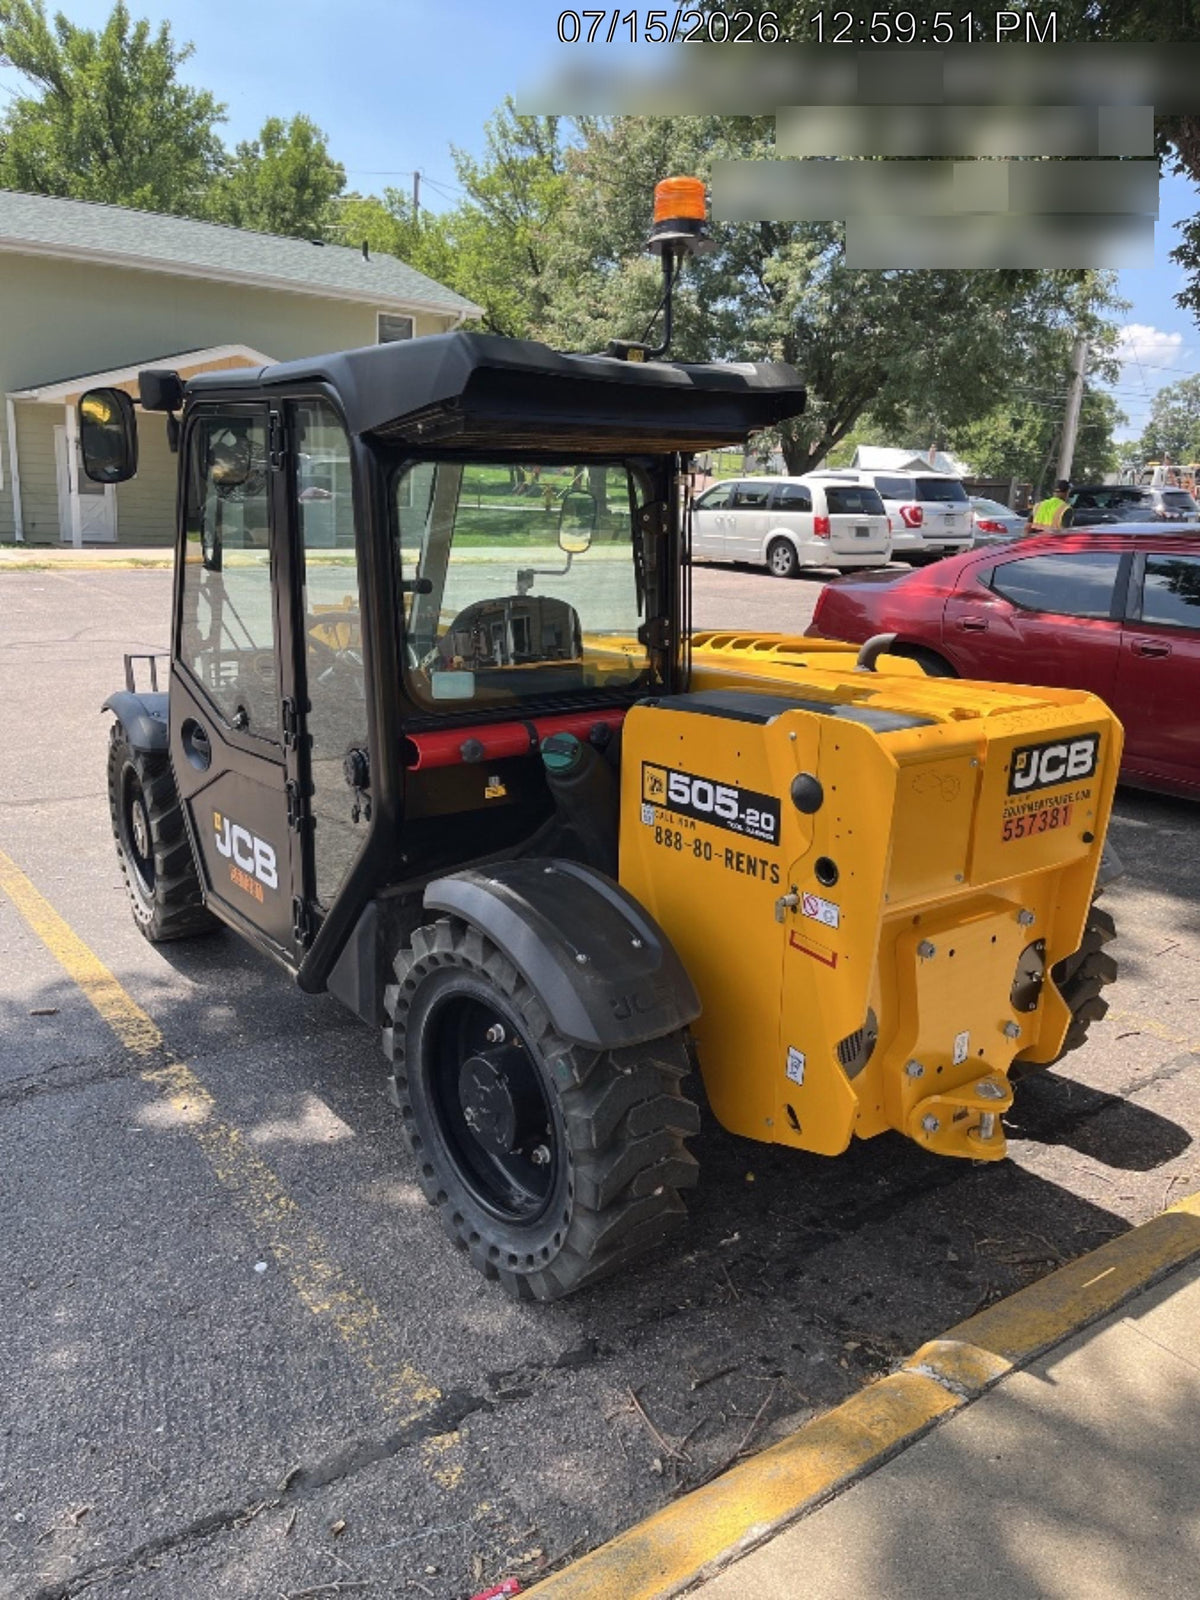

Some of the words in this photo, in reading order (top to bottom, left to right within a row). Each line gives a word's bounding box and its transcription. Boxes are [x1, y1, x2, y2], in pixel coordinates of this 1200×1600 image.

[1013, 740, 1095, 789] JCB
[1003, 805, 1069, 842] 557381
[214, 814, 278, 889] JCB
[655, 826, 780, 884] 888-80-RENTS
